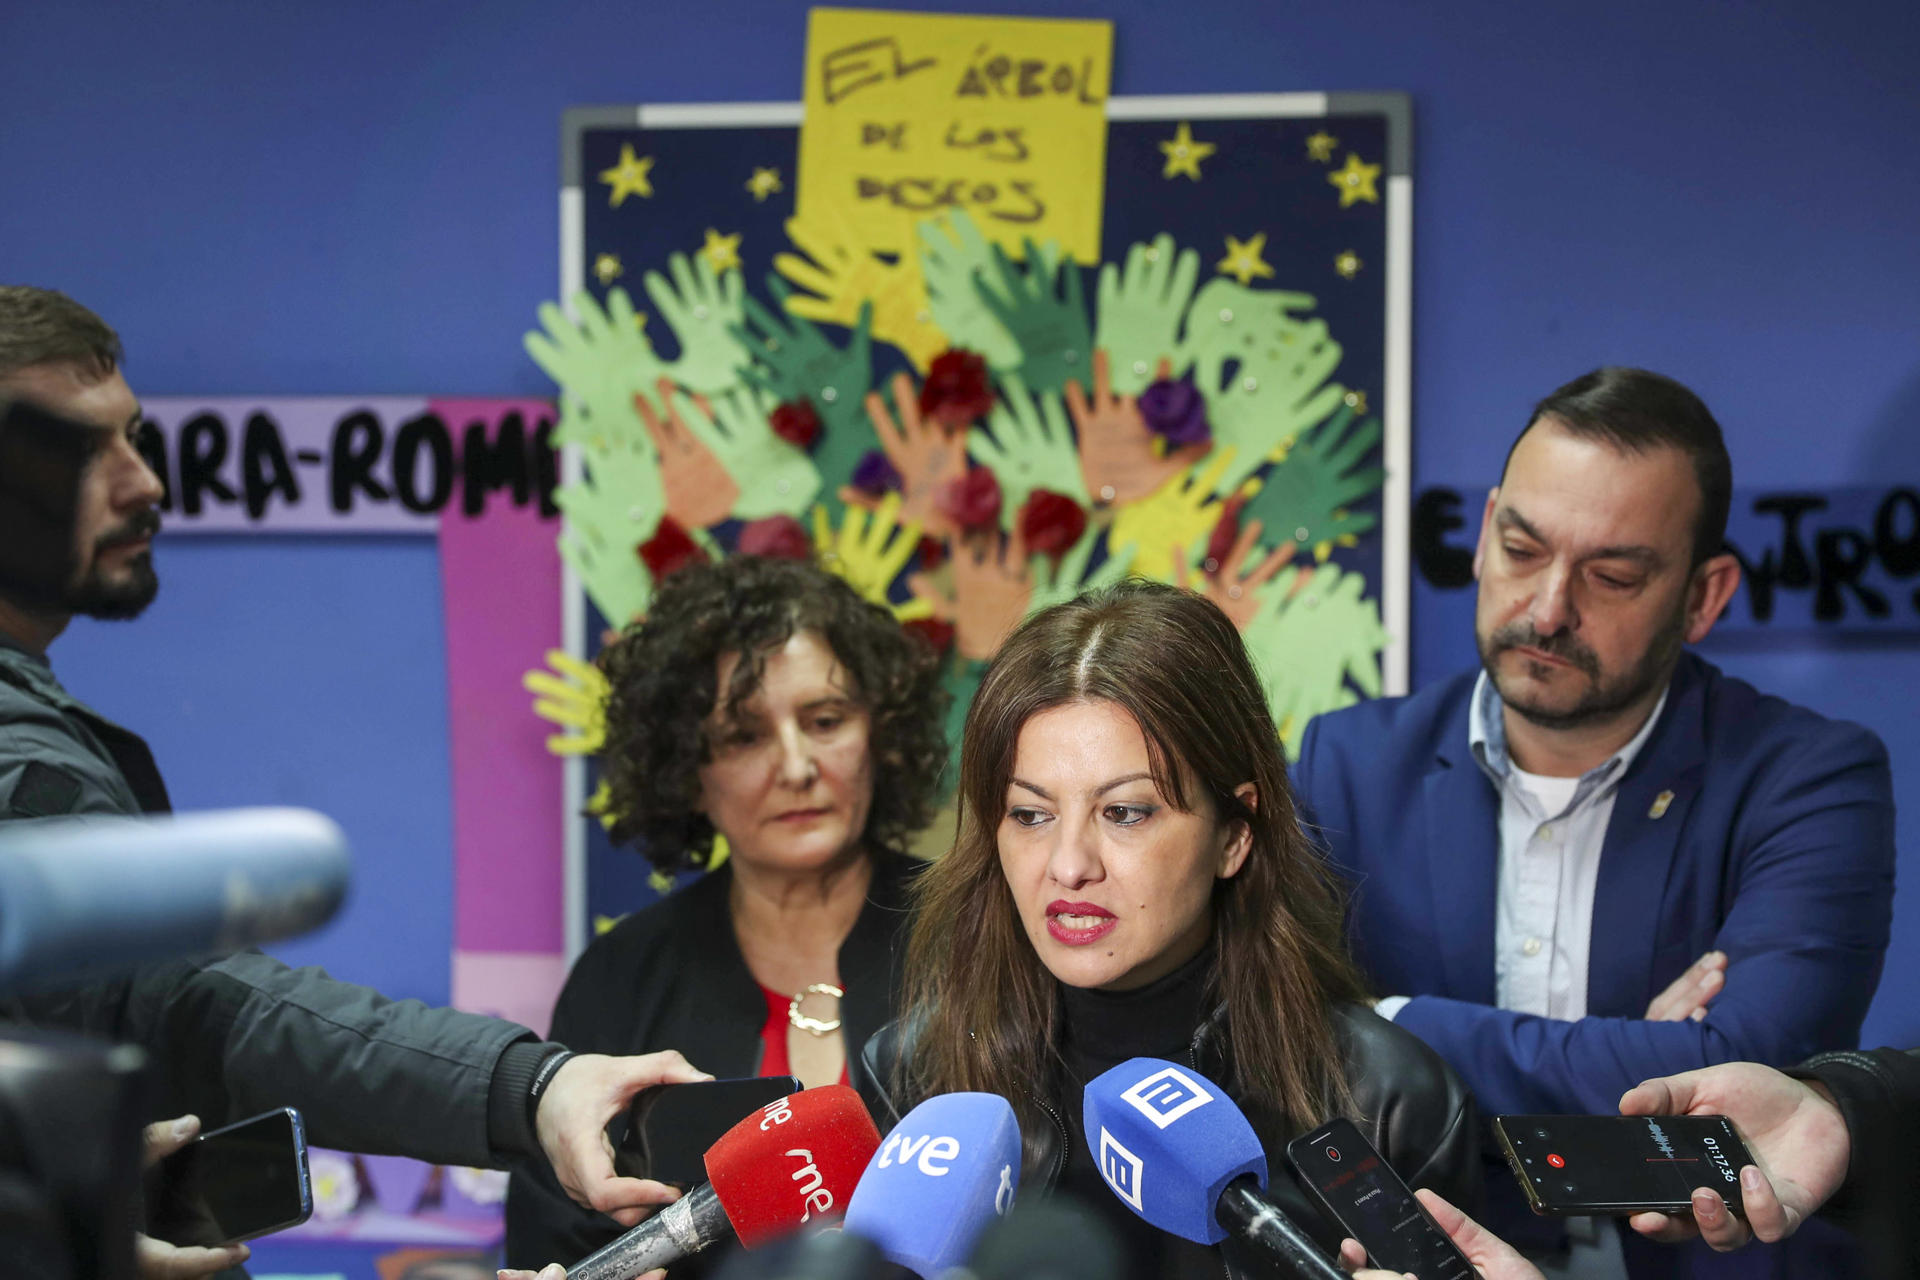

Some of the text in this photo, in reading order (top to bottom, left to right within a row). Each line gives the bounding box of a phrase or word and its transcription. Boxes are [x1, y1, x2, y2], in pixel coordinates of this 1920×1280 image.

[822, 37, 937, 104] EL
[860, 122, 908, 153] DE
[878, 1133, 960, 1177] tve
[1703, 1137, 1738, 1182] 01:17.36
[784, 1148, 834, 1224] rne
